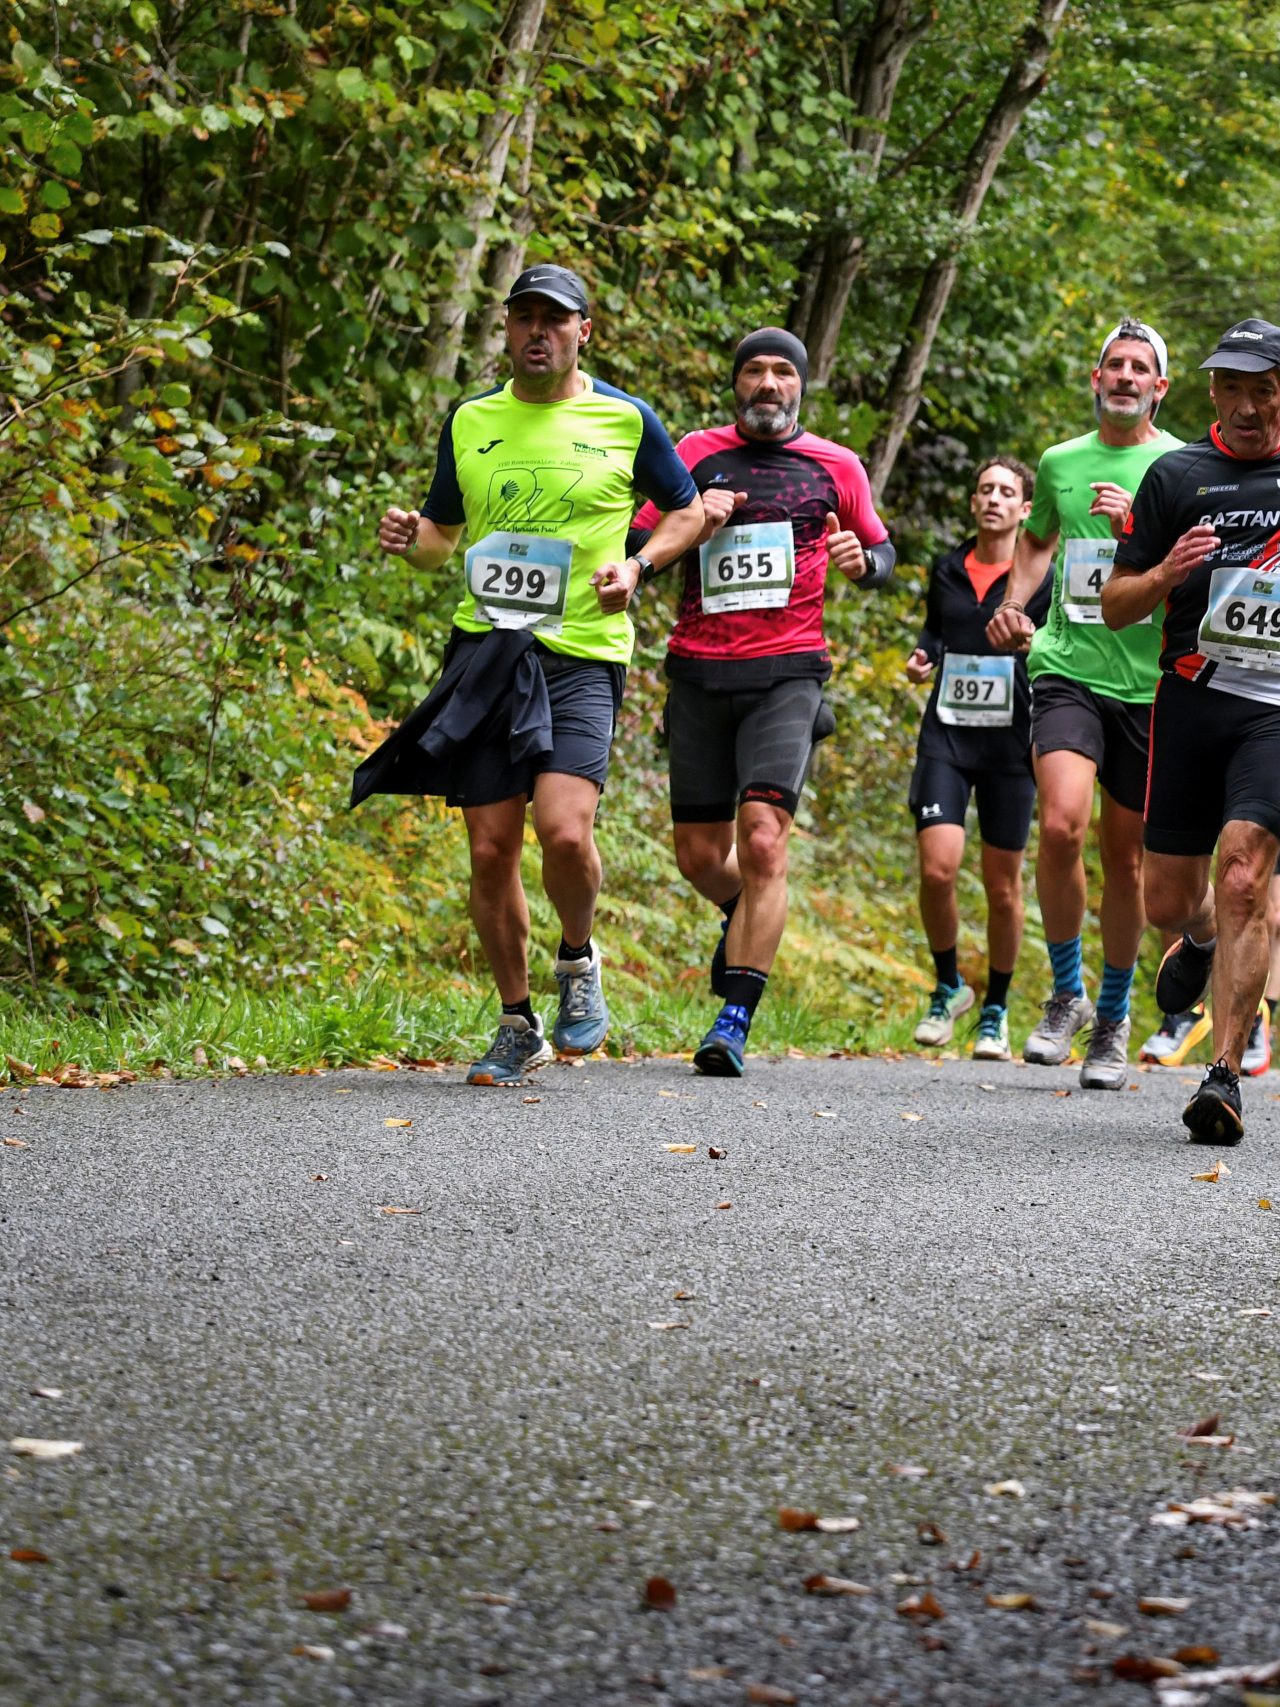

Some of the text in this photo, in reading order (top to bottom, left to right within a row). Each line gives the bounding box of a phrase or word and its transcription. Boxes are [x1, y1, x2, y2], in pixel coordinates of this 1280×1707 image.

[482, 563, 546, 599] 299
[718, 552, 773, 581] 655
[953, 679, 995, 701] 897
